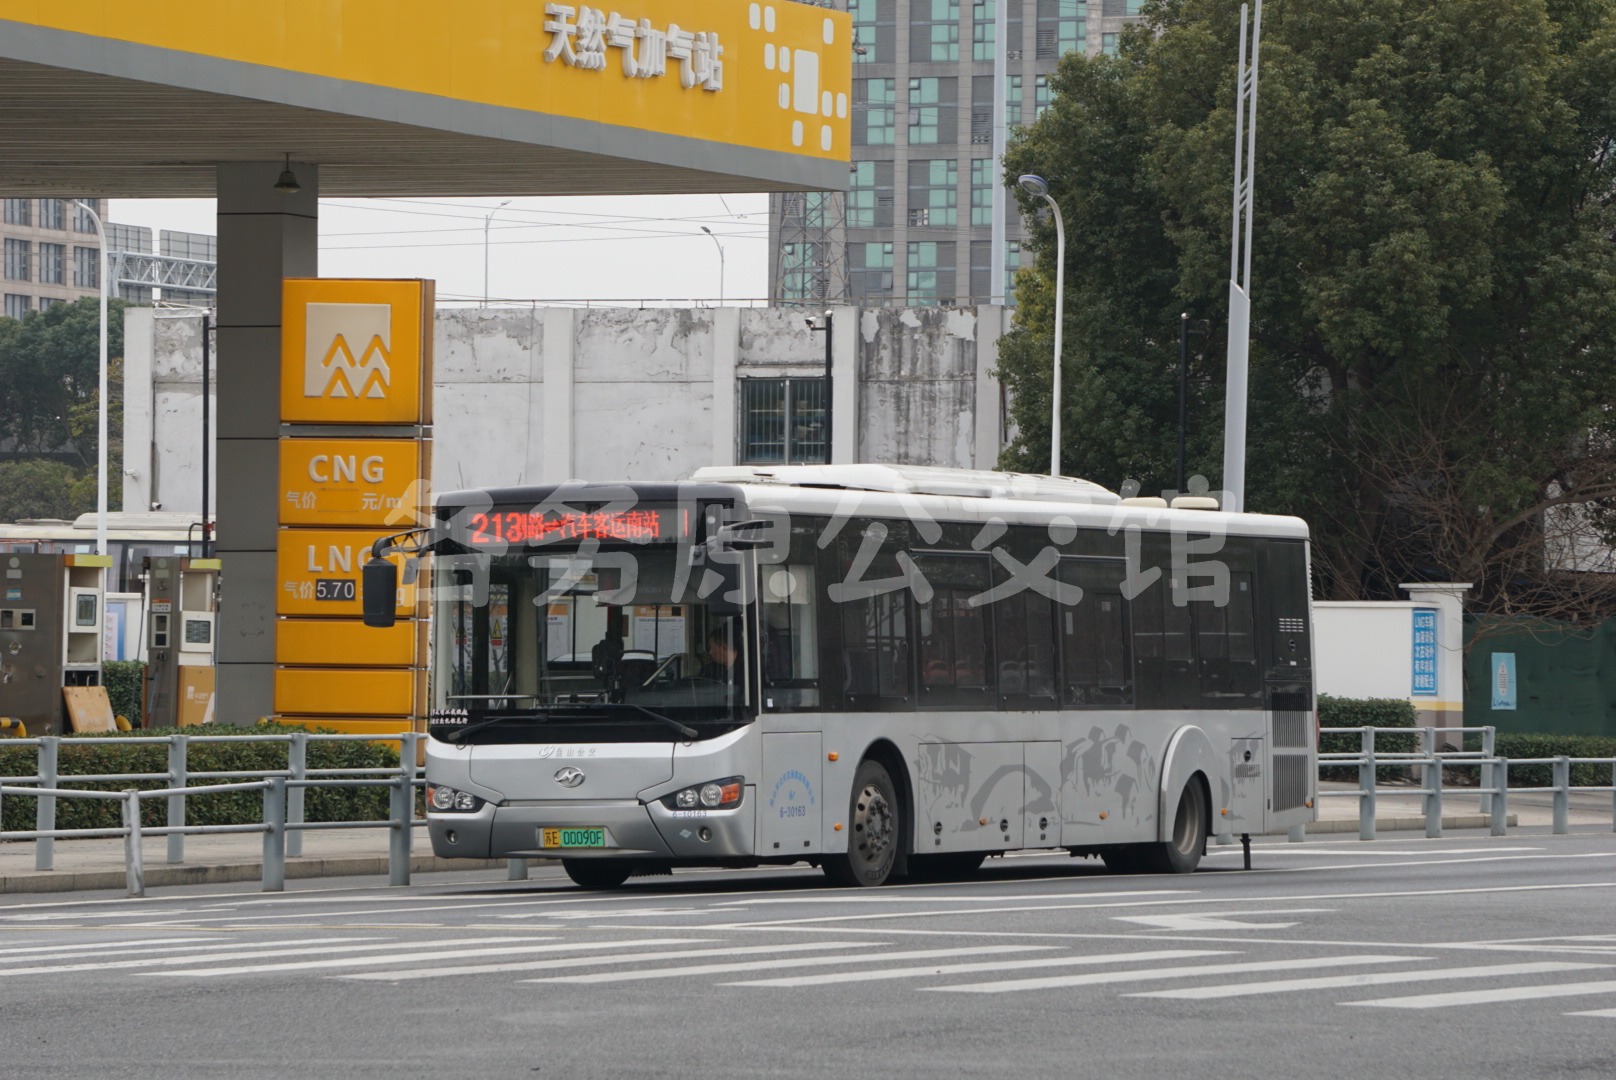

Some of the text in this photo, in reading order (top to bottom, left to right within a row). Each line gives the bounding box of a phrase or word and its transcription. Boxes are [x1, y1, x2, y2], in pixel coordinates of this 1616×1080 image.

[543, 3, 724, 92] 天然气加气站
[308, 455, 384, 483] CNG
[286, 491, 316, 510] 气价
[561, 510, 659, 540] 汽车客运南站
[285, 581, 315, 600] 气价
[316, 582, 354, 599] 5.70
